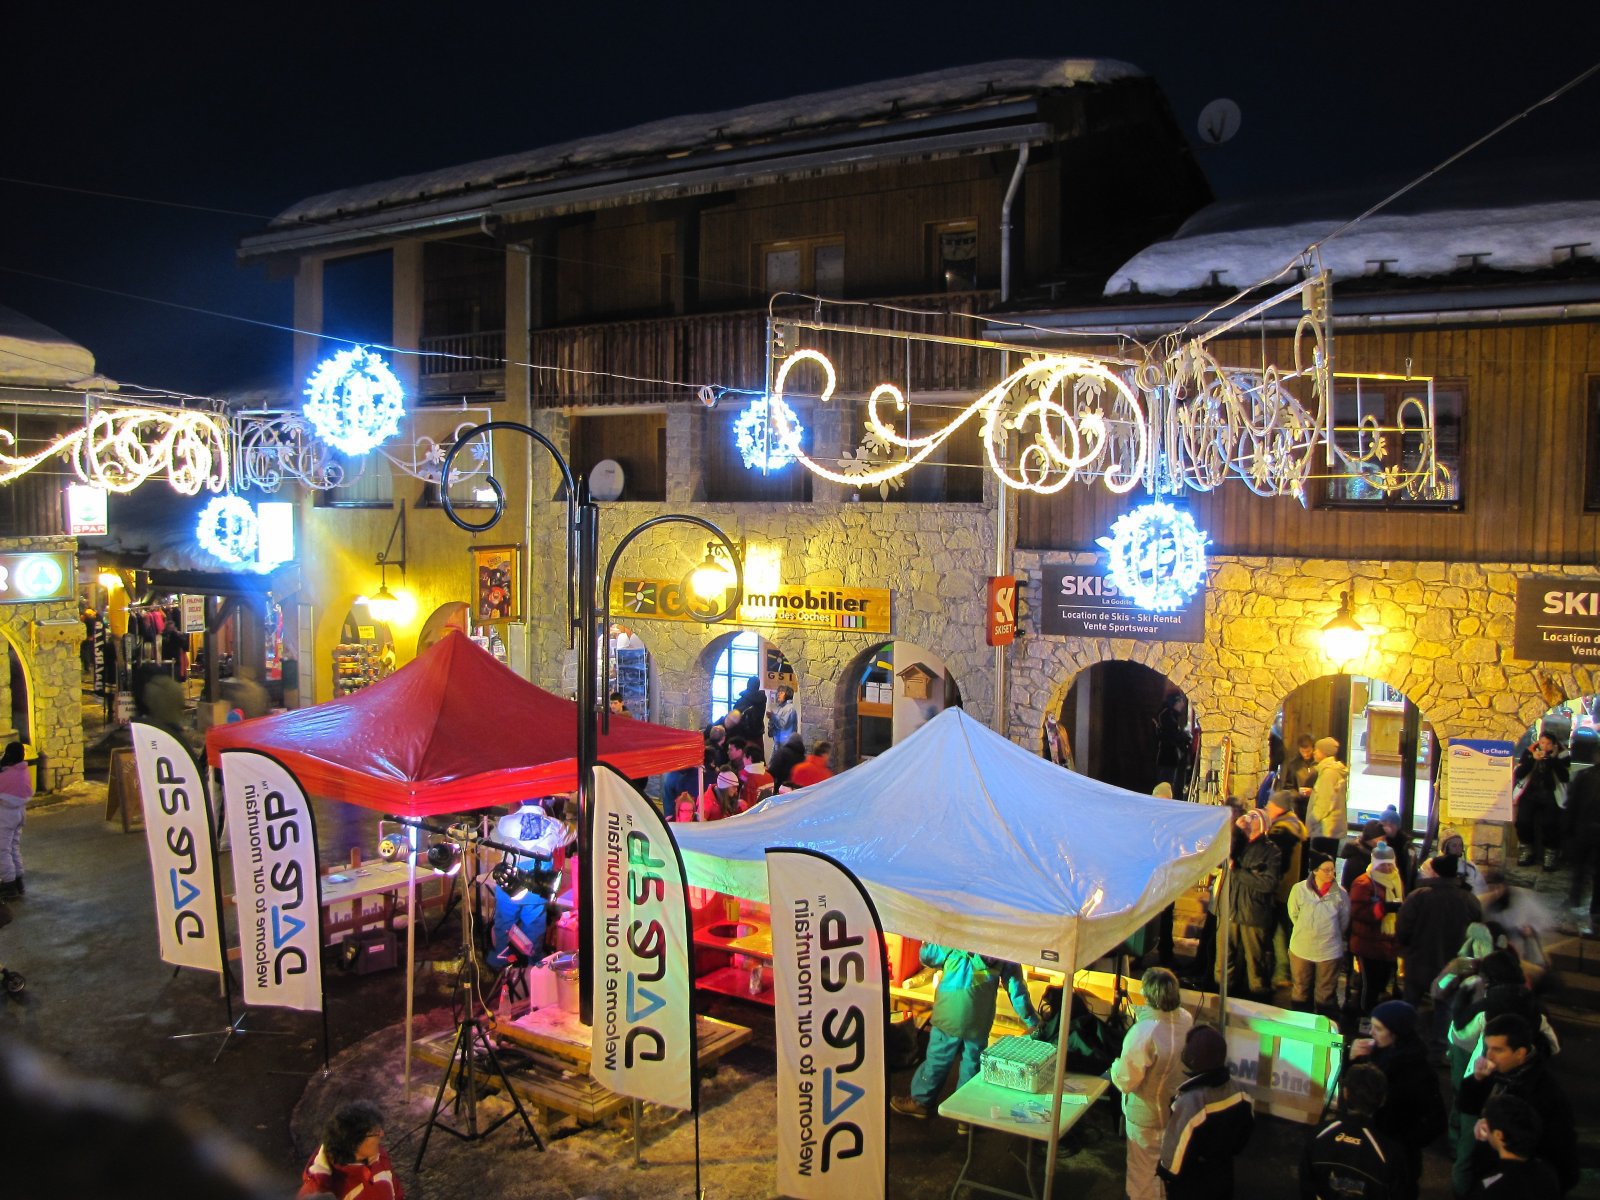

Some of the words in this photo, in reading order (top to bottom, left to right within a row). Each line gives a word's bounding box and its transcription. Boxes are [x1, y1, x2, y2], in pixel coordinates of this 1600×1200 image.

[73, 525, 105, 533] SPAR
[1542, 590, 1600, 616] SKI
[779, 610, 795, 620] des
[798, 610, 830, 623] Coches
[1062, 610, 1097, 621] Location
[1099, 611, 1109, 621] de
[1111, 612, 1129, 622] Skis
[1137, 613, 1151, 623] Ski
[1153, 614, 1181, 624] Rental
[995, 624, 1013, 635] SKISET
[1083, 621, 1107, 632] Vente
[1109, 622, 1158, 634] Sportswear
[1542, 631, 1591, 644] Location
